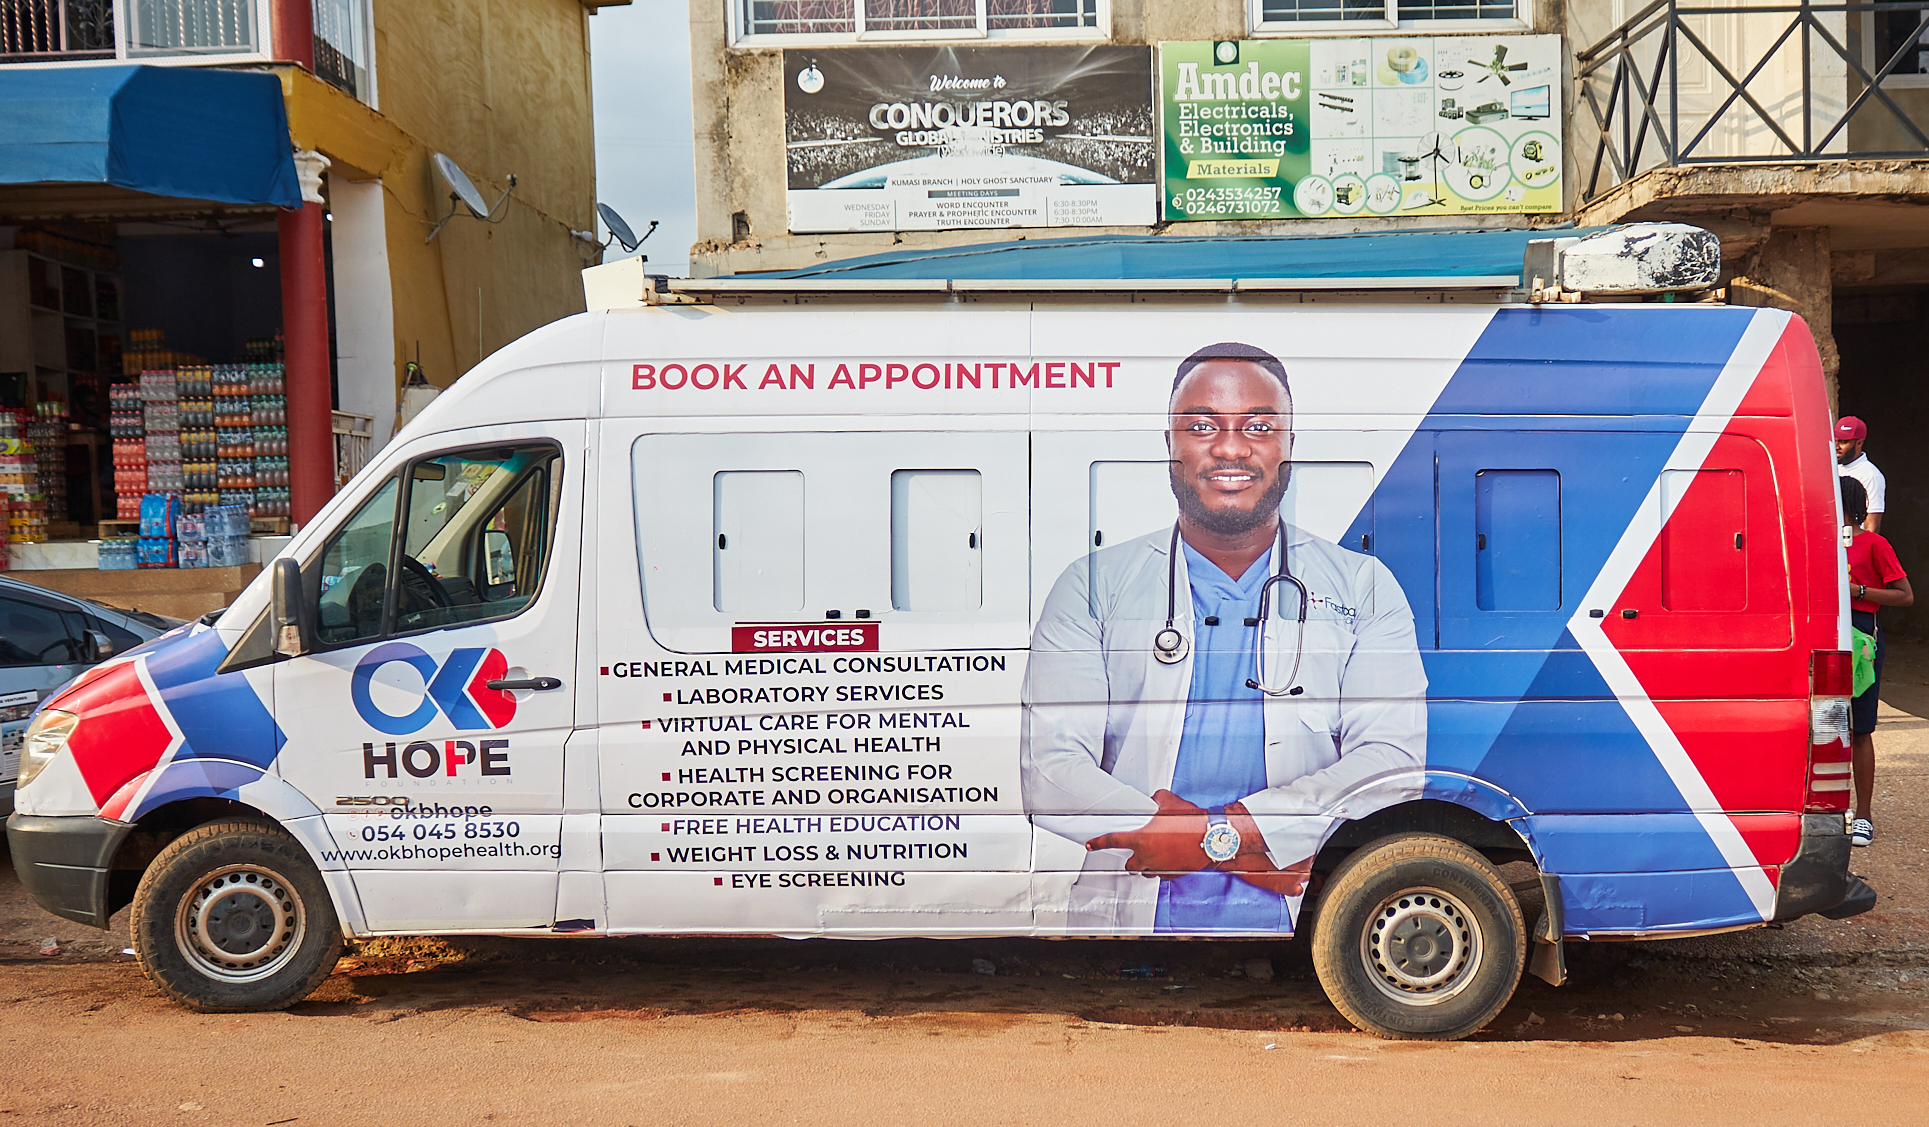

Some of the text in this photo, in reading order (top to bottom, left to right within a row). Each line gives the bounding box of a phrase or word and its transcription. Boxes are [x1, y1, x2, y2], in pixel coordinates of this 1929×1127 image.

[930, 74, 1006, 92] Welcome to
[1173, 61, 1302, 101] Amdec
[869, 100, 1070, 130] CONQUERORS
[1178, 102, 1295, 122] Electricals,
[960, 128, 1044, 145] MNISTRIES
[1178, 120, 1294, 137] Electronics
[1179, 137, 1286, 157] & Building
[1197, 162, 1271, 176] Materials
[922, 178, 953, 186] BRANCH
[983, 177, 1008, 185] GHOST
[1009, 176, 1053, 184] SANCTUARY
[946, 190, 979, 198] MEETING
[1186, 188, 1282, 201] 0243534257
[844, 203, 890, 211] WEDNESDAY
[946, 209, 989, 217] PROPHETIC
[991, 208, 1037, 216] ENCOUNTER
[1186, 201, 1281, 214] 0246731072
[1508, 203, 1524, 211] can't
[1525, 204, 1552, 212] compare
[963, 217, 1010, 225] ENCOUNTER
[632, 361, 1121, 391] BOOK AN APPOINTMENT
[753, 629, 865, 648] SERVICES
[613, 655, 1007, 678] GENERAL MEDICAL CONSULTATION
[677, 684, 944, 705] LABORATORY SERVICES
[657, 712, 970, 733] VIRTUAL CARE FOR MENTAL
[680, 736, 941, 756] AND PHYSICAL HEALTH
[363, 739, 511, 779] HOPE
[365, 778, 514, 788] FOUNDATION
[678, 764, 953, 784] HEALTH SCREENING FOR
[335, 795, 410, 806] 2500
[627, 786, 999, 809] CORPORATE AND ORGANISATION
[390, 802, 493, 822] okbhope
[361, 821, 520, 842] 054 045 8530
[673, 814, 961, 835] FREE HEALTH EDUCATION
[320, 841, 562, 862] www.okbhopehealth.org
[666, 842, 968, 863] WEIGHT LOSS & NUTRITION
[731, 871, 906, 889] EYE SCREENING
